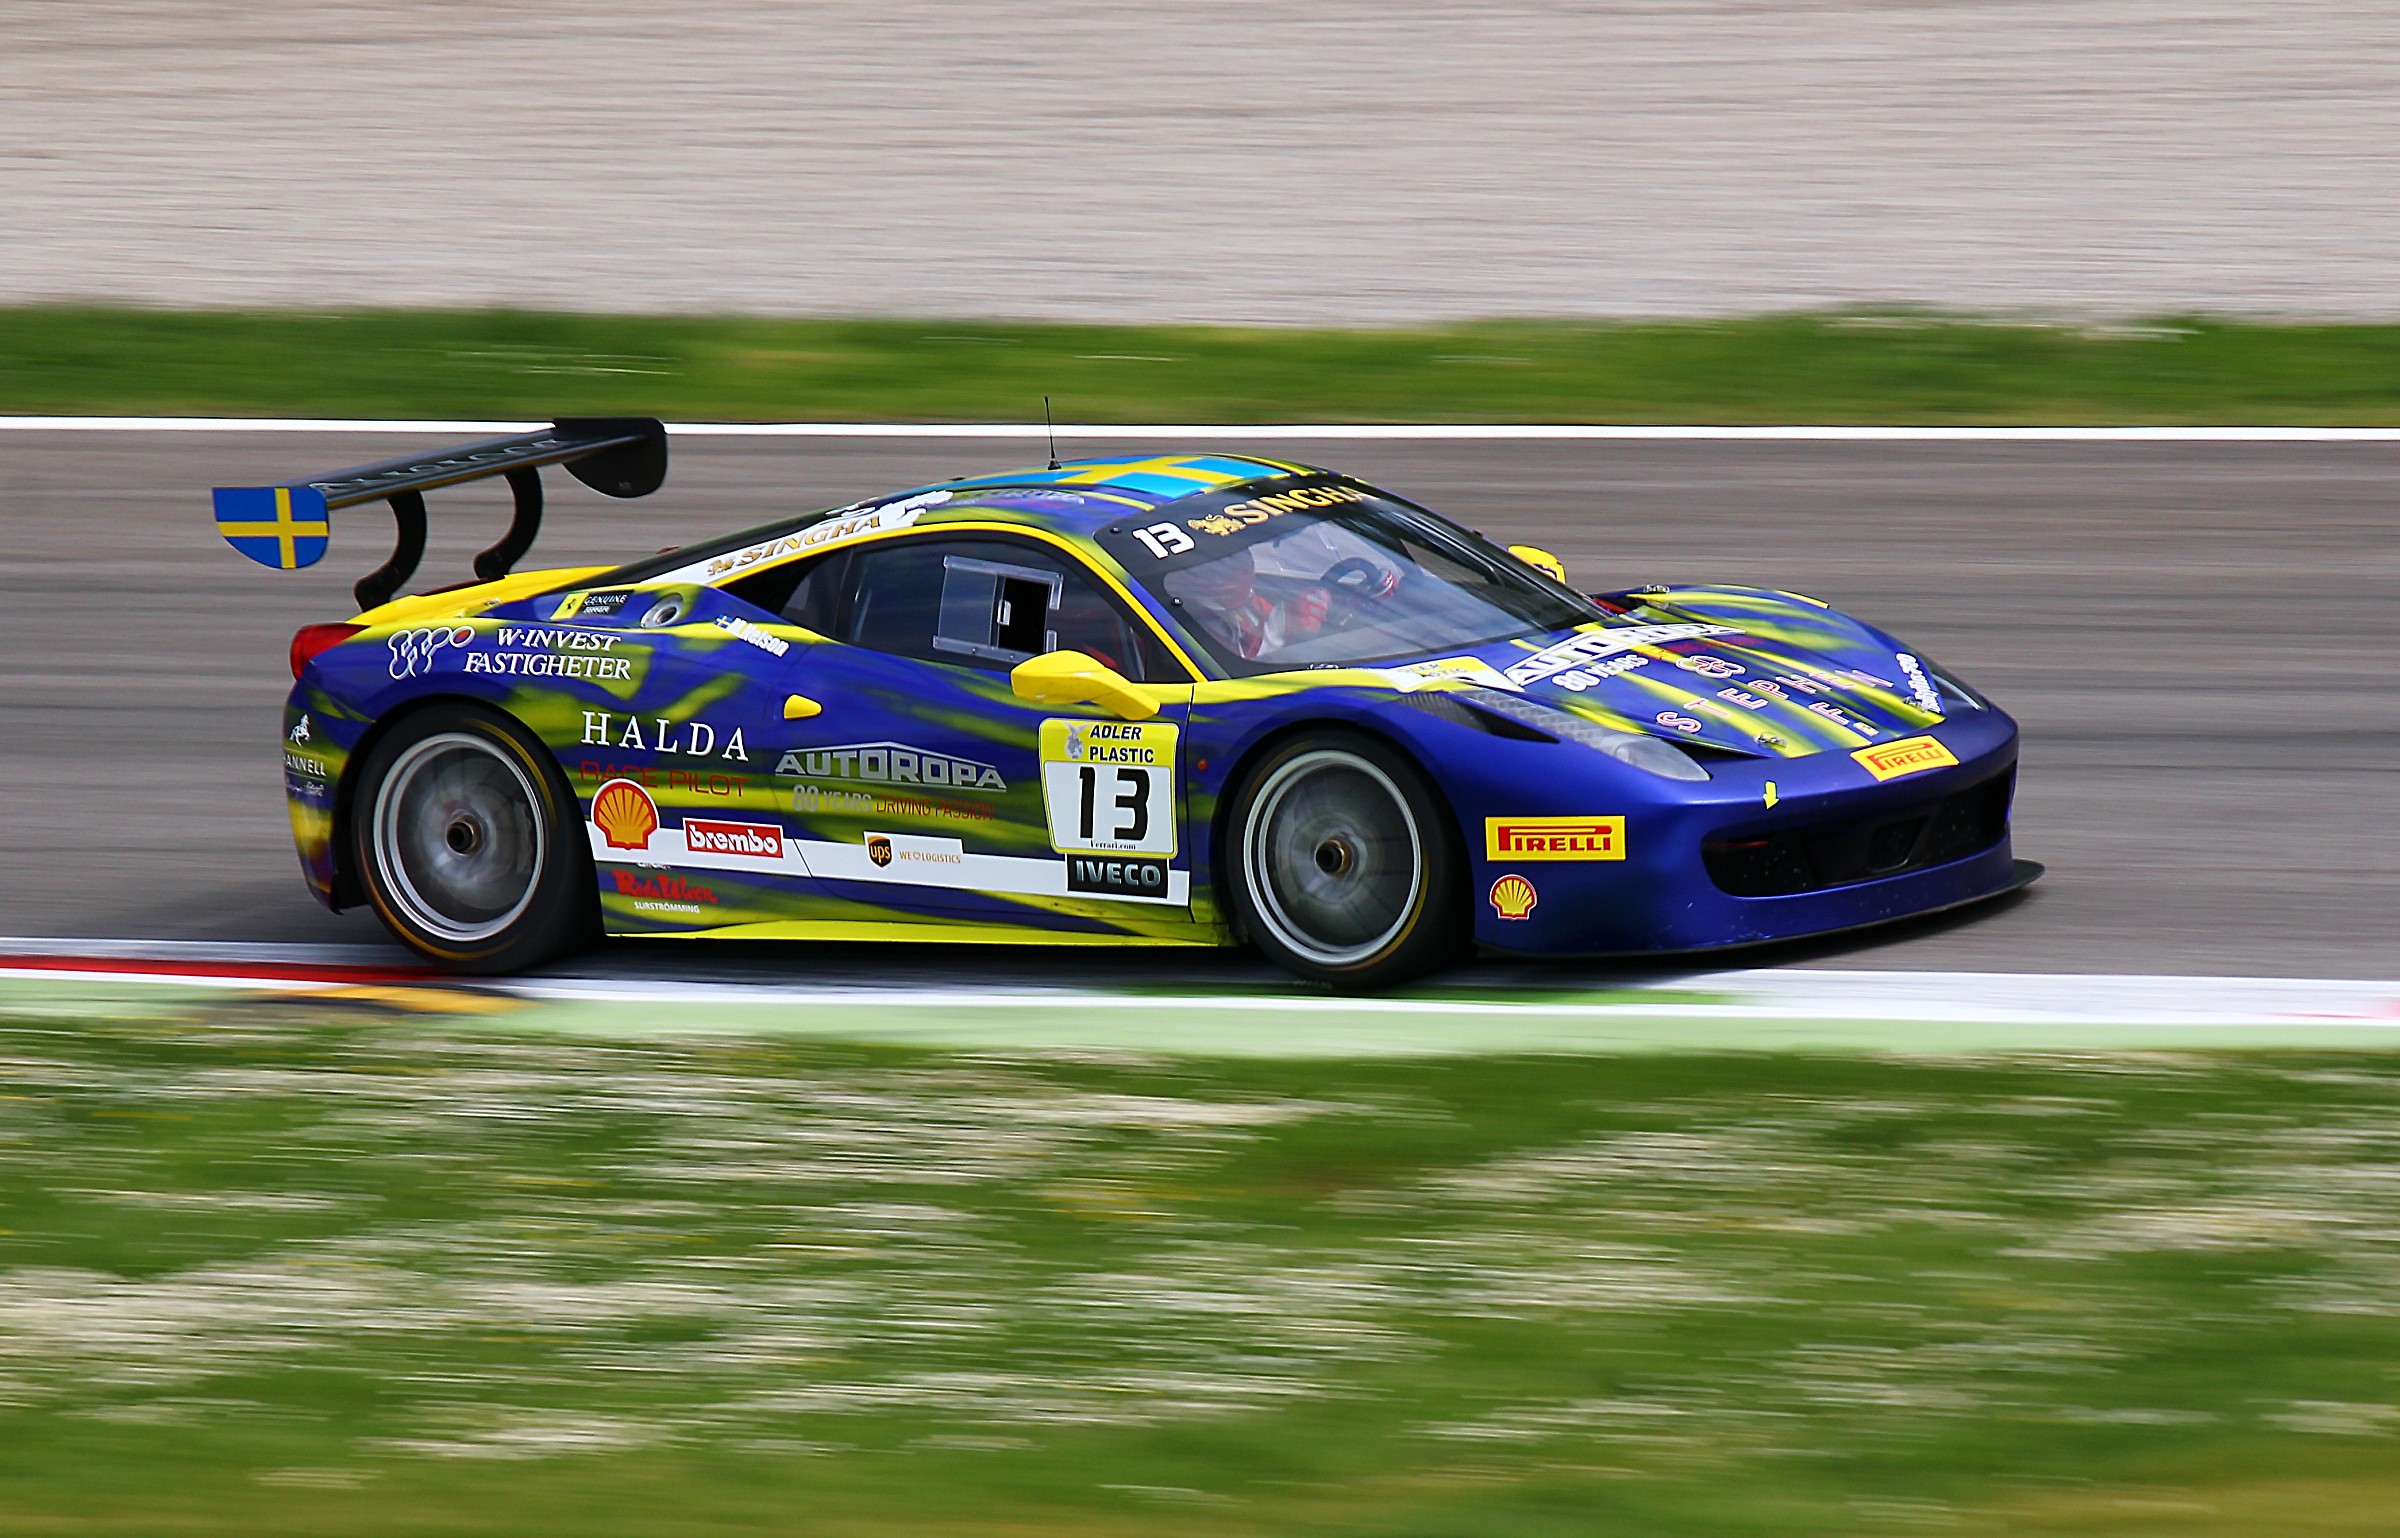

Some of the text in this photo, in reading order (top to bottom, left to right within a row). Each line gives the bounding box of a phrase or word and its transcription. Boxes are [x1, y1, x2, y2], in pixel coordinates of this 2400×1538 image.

[1223, 485, 1381, 526] SINGHA
[736, 513, 881, 568] SINGHA
[1131, 521, 1196, 559] 13
[584, 594, 629, 606] GENUINE
[463, 651, 632, 681] FASTIGHETER
[1591, 653, 1650, 680] YEARS
[581, 709, 749, 763] HALDA
[1089, 724, 1143, 741] ADLER
[283, 753, 328, 777] ANNELL
[775, 747, 1007, 790] AUTOROPA
[1089, 746, 1155, 764] PLASTIC
[1866, 742, 1945, 771] PIRELLI
[669, 769, 749, 798] PILOT
[793, 783, 996, 822] 80 YEARS DRIVING PASSION
[1078, 765, 1151, 842] 13
[689, 824, 779, 855] brembo
[1497, 826, 1613, 852] PIRELLI
[870, 845, 961, 865] ups WE LOGISTICS
[1075, 859, 1162, 888] IVECO
